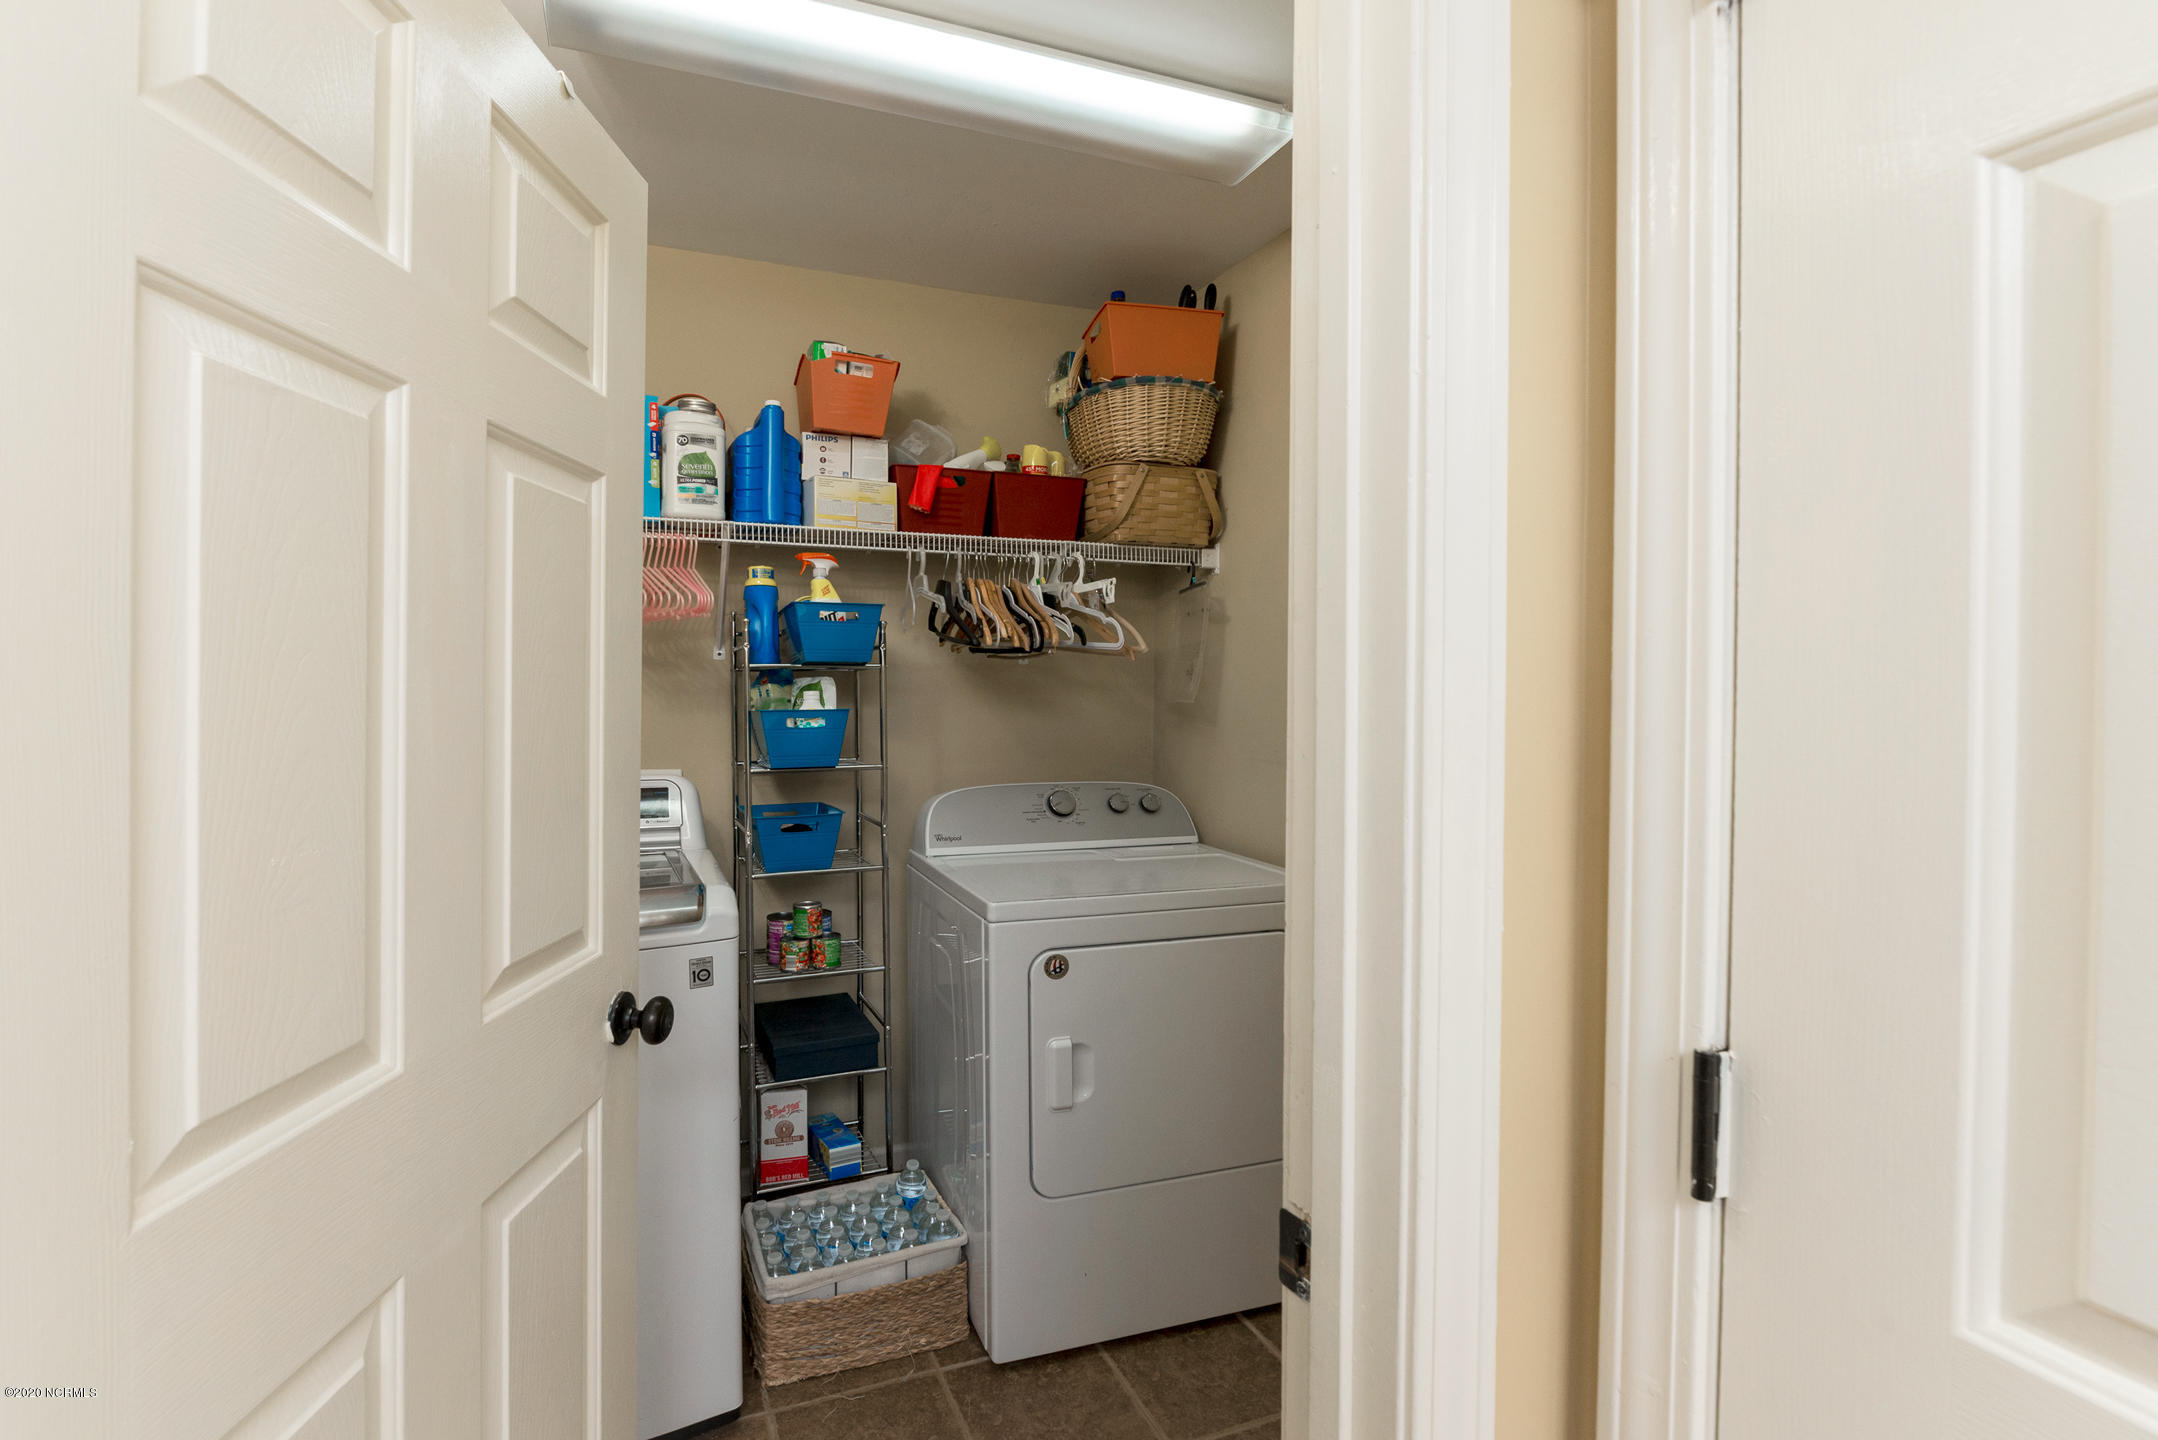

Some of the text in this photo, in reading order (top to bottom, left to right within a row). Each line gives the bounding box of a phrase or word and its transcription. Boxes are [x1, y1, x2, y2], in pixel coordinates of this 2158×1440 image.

[805, 434, 839, 443] PHILIPS
[681, 462, 713, 470] seventh
[934, 833, 962, 843] Whirlpool
[692, 968, 711, 983] 10
